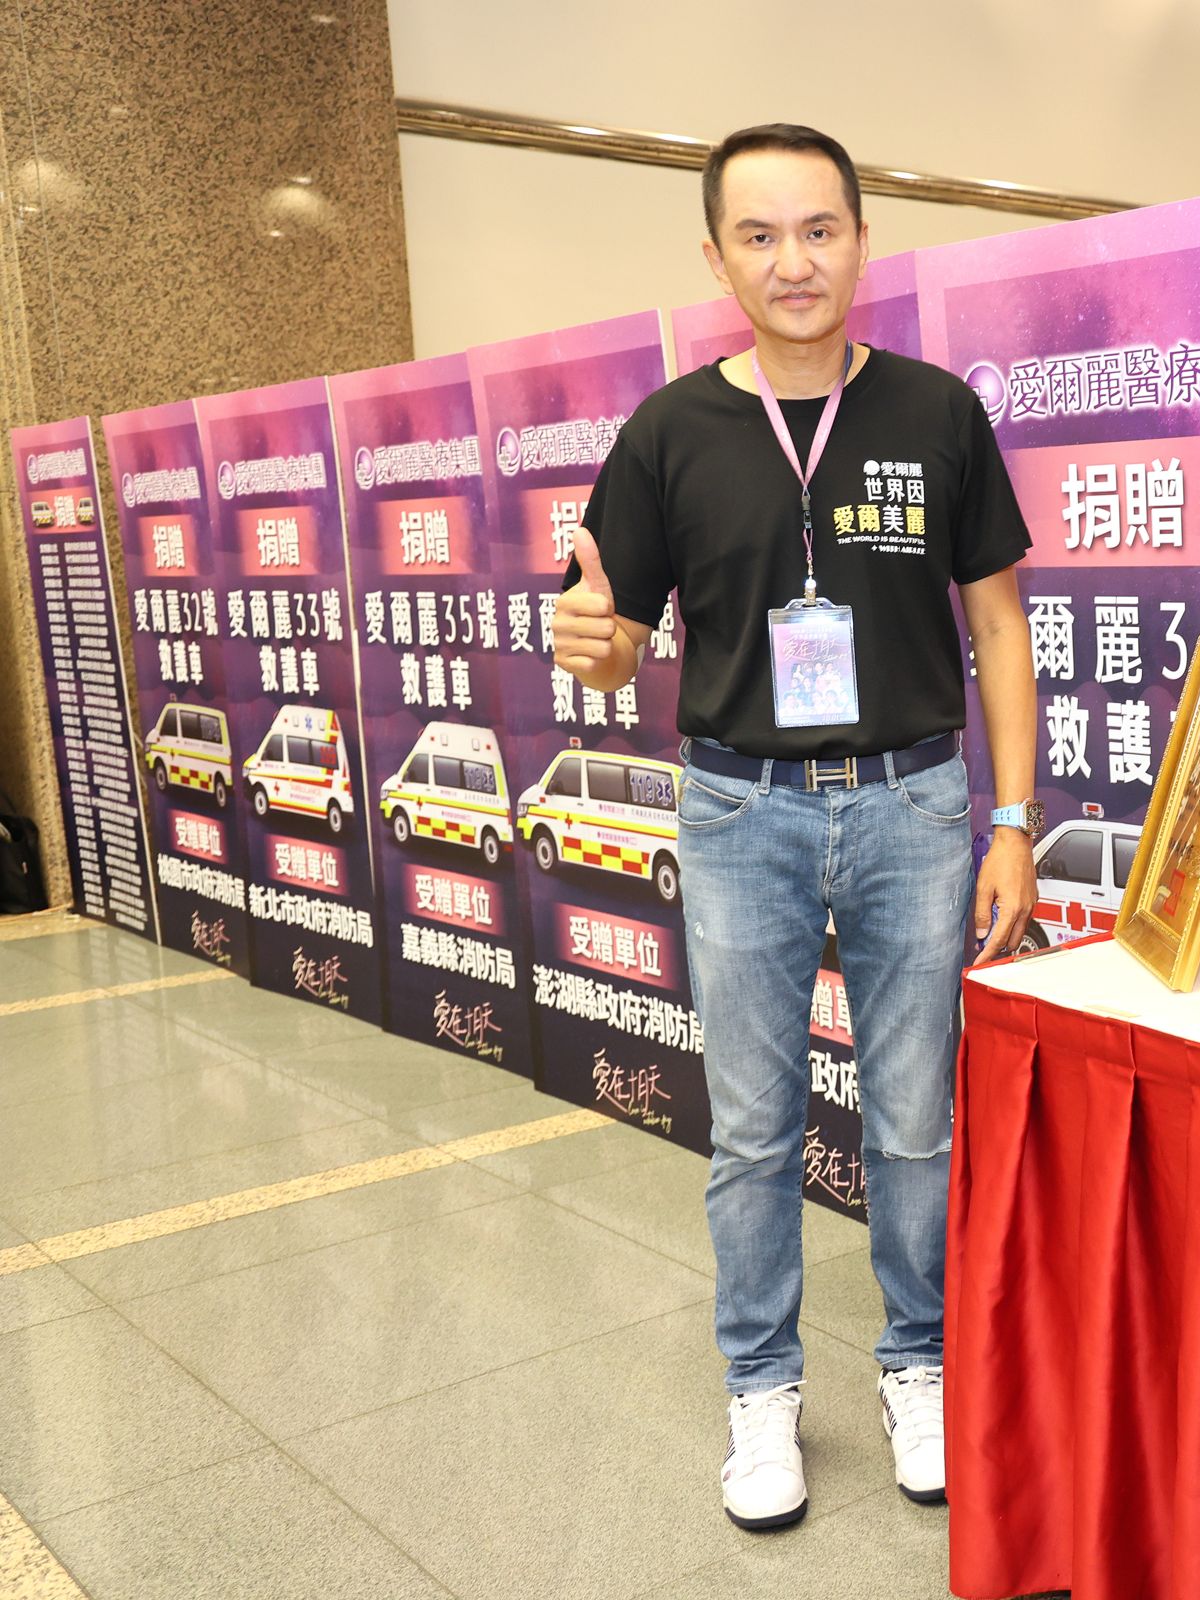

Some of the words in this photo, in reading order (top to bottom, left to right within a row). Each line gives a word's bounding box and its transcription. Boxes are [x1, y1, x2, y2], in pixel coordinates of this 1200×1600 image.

[519, 415, 628, 471] 愛爾麗醫療
[880, 461, 924, 478] 愛爾麗
[864, 477, 925, 504] 世界因
[1061, 457, 1184, 550] 捐贈
[256, 517, 300, 567] 捐贈
[400, 510, 450, 565] 捐贈
[550, 500, 589, 562] 捐
[833, 504, 925, 535] 愛爾美麗
[837, 537, 852, 545] THE
[852, 535, 880, 543] WORLD
[889, 536, 925, 545] BEAUTIFUL
[134, 588, 218, 636] 愛爾麗32號
[227, 588, 343, 641] 愛爾麗33號
[364, 588, 499, 649] 愛爾麗35號
[258, 644, 320, 697] 救護車
[400, 652, 472, 711] 救護車
[1046, 695, 1178, 786] 救護
[628, 773, 655, 804] 119
[275, 843, 340, 887] 受贈單位
[249, 883, 374, 948] 新北市政府消防局
[415, 874, 492, 925] 受贈單位
[400, 923, 516, 989] 嘉義縣消防局
[569, 915, 662, 977] 受贈單位
[532, 963, 704, 1054] 澎湖縣政府消防局
